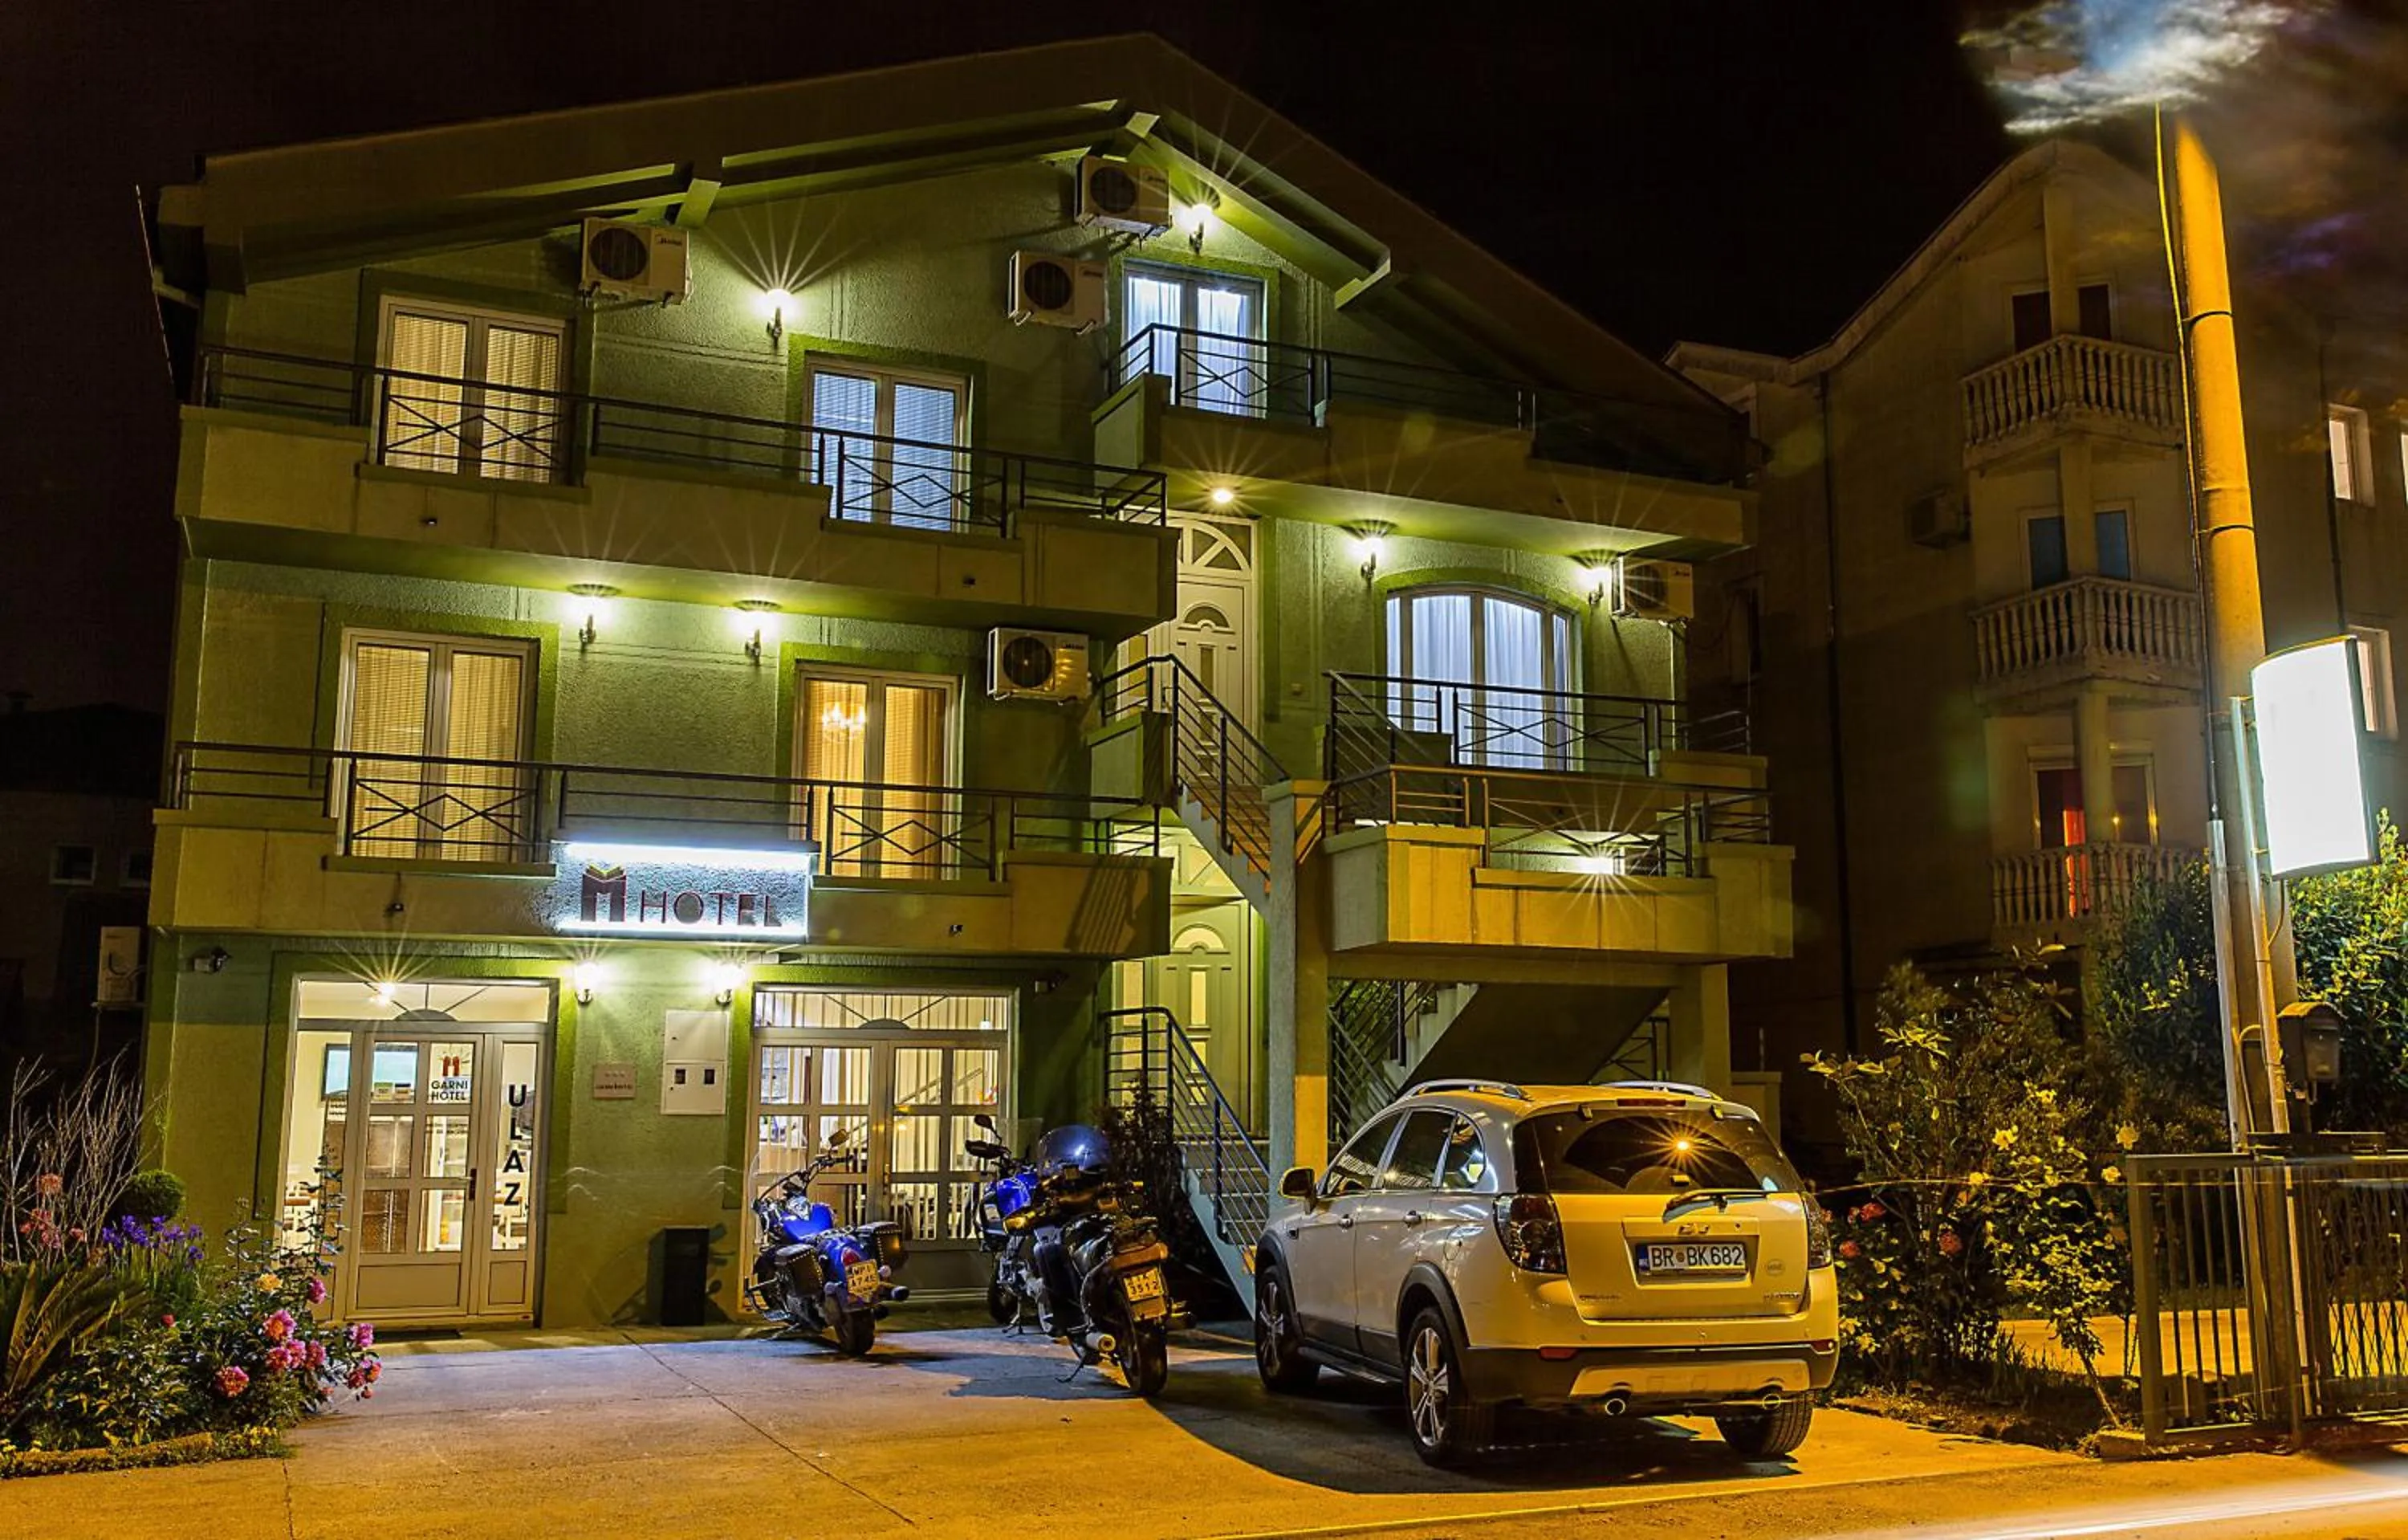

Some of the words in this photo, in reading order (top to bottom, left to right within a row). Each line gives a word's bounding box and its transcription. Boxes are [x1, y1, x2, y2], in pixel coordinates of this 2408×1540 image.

[640, 890, 782, 927] HOTEL
[431, 1080, 468, 1090] GARNI
[431, 1091, 466, 1101] HOTEL
[502, 1084, 527, 1206] ULAZ
[1651, 1246, 1674, 1267] BR
